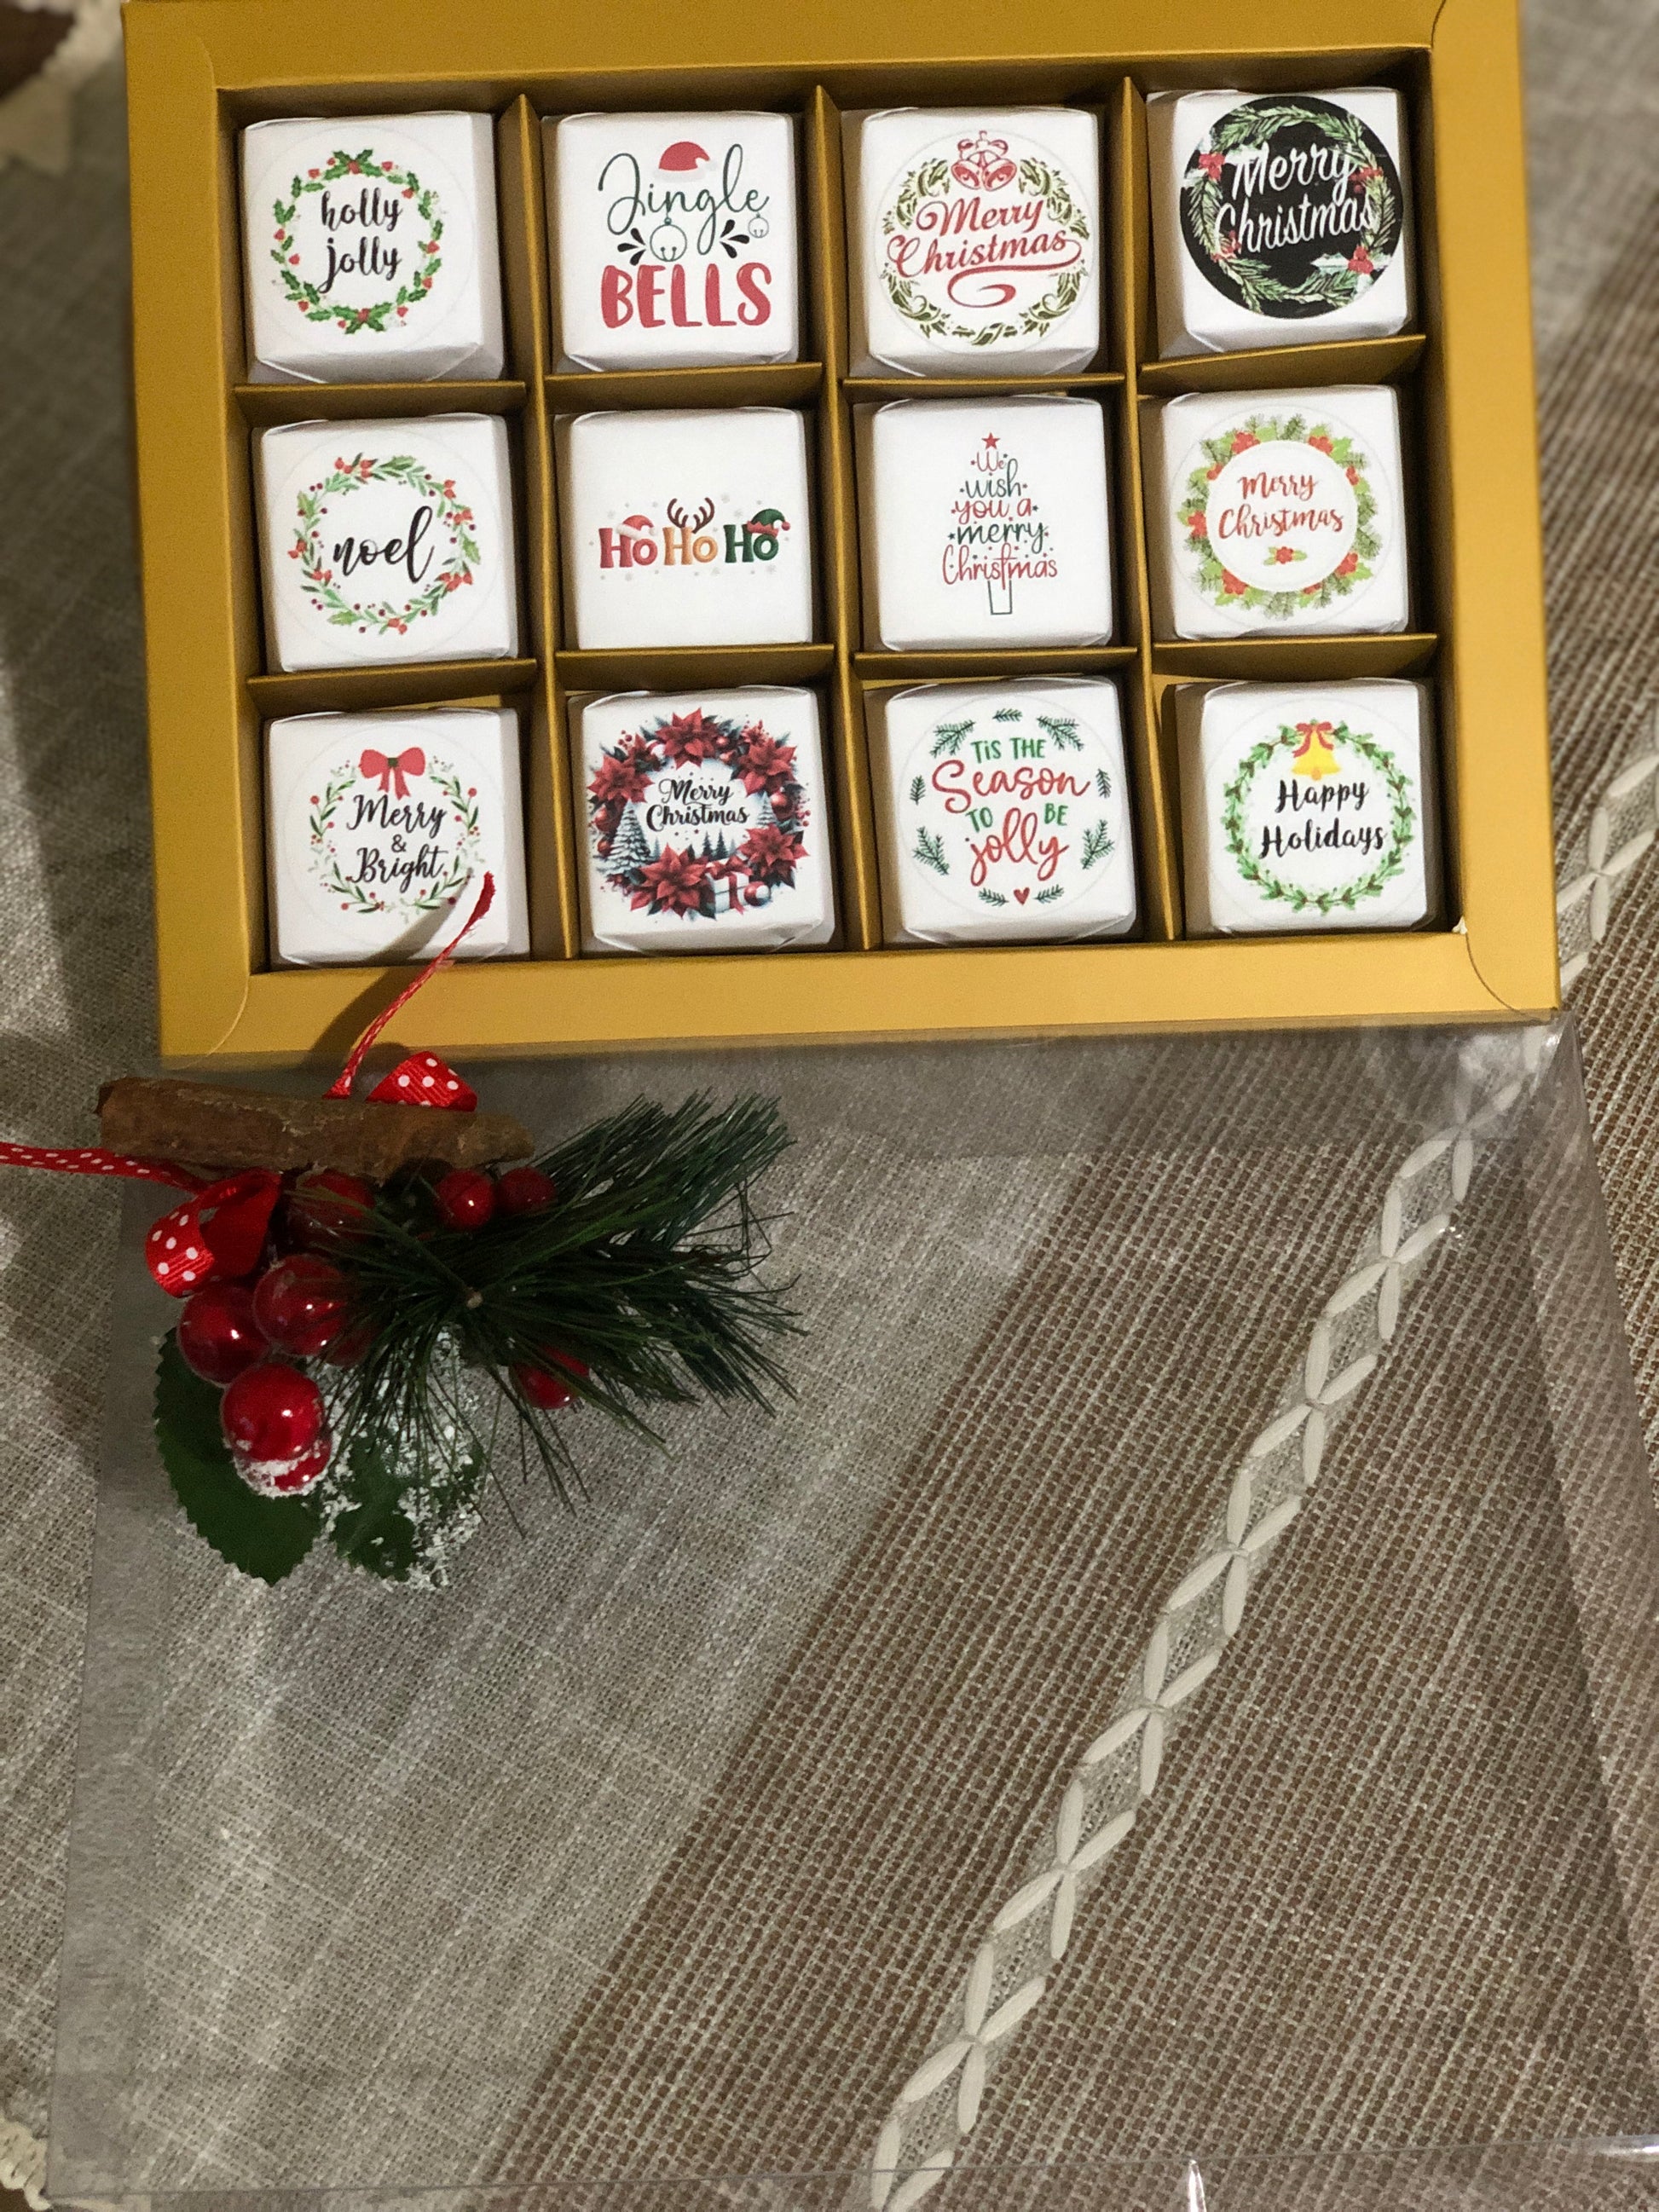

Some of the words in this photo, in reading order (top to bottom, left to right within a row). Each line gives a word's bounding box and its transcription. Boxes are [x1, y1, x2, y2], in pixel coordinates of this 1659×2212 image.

[1231, 141, 1357, 206] Merry
[321, 187, 403, 232] holly
[598, 143, 770, 256] Jingle
[916, 196, 1044, 237] Merry
[1213, 193, 1373, 254] Christmas
[317, 235, 402, 294] jolly
[887, 229, 1083, 278] Christmas
[600, 262, 772, 329] BELLS
[965, 458, 1022, 499] wish
[976, 451, 1005, 472] We
[1239, 471, 1319, 501] Merry
[954, 500, 1009, 525] you
[1017, 498, 1032, 517] a
[1218, 504, 1344, 540] Christmas
[332, 505, 435, 584] noel
[957, 522, 1049, 554] merry
[942, 542, 1058, 591] Christmas
[1009, 737, 1047, 759] THE
[658, 778, 734, 805] Merry
[932, 759, 1091, 813] Season
[1275, 779, 1369, 813] Happy
[346, 794, 448, 839] Merry
[645, 801, 750, 832] Christmas
[965, 807, 993, 833] TO
[1043, 803, 1068, 826] BE
[390, 834, 407, 852] &
[965, 807, 1070, 887] jolly
[1258, 817, 1386, 859] Holidays
[350, 844, 448, 893] Bright
